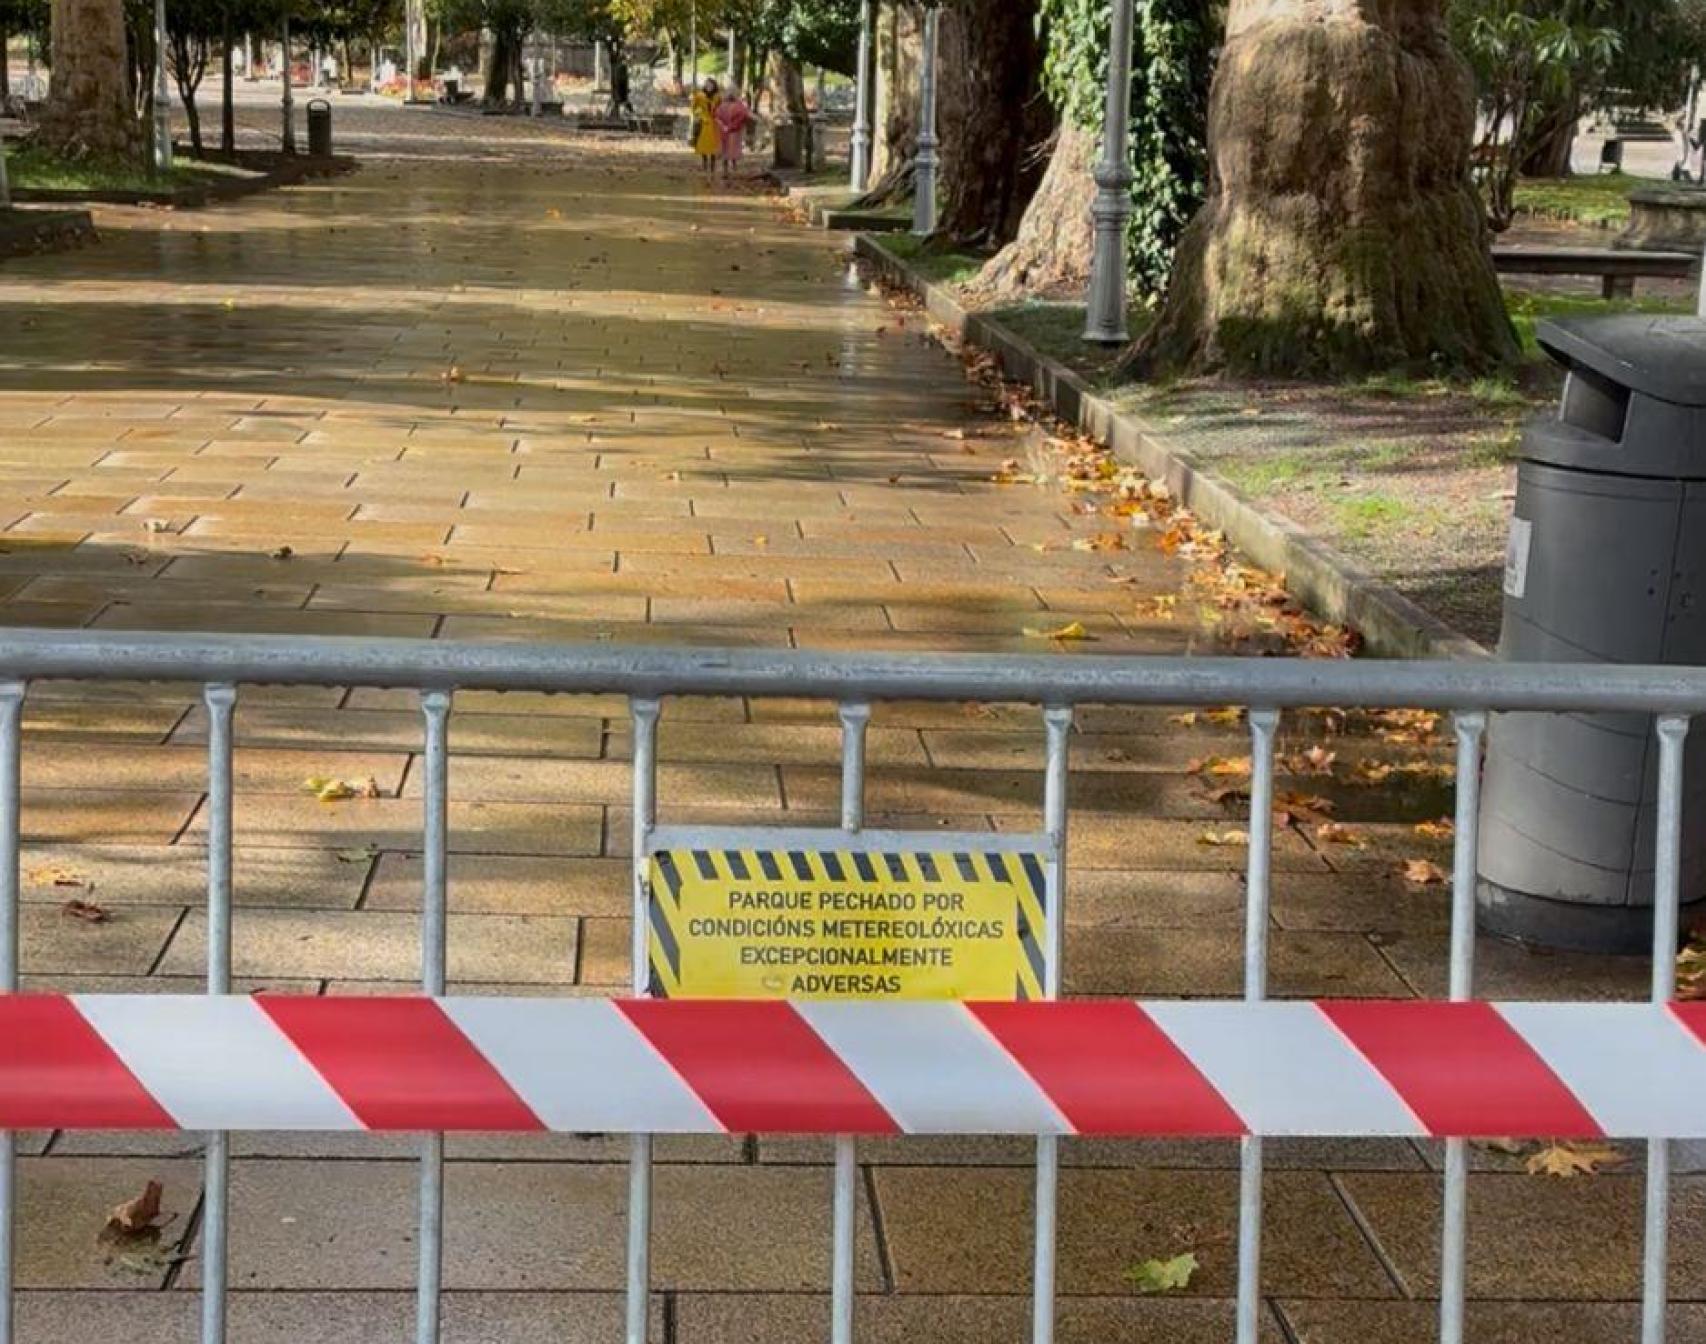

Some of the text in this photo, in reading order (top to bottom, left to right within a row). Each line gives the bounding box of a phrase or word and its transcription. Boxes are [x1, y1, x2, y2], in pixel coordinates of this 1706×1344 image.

[728, 891, 964, 911] PARQUE PECHADO POR
[689, 915, 1004, 939] CONDICIÓNS METEREOLÓXICAS
[740, 946, 953, 967] EXCEPCIONALMENTE
[791, 975, 901, 993] ADVERSAS
